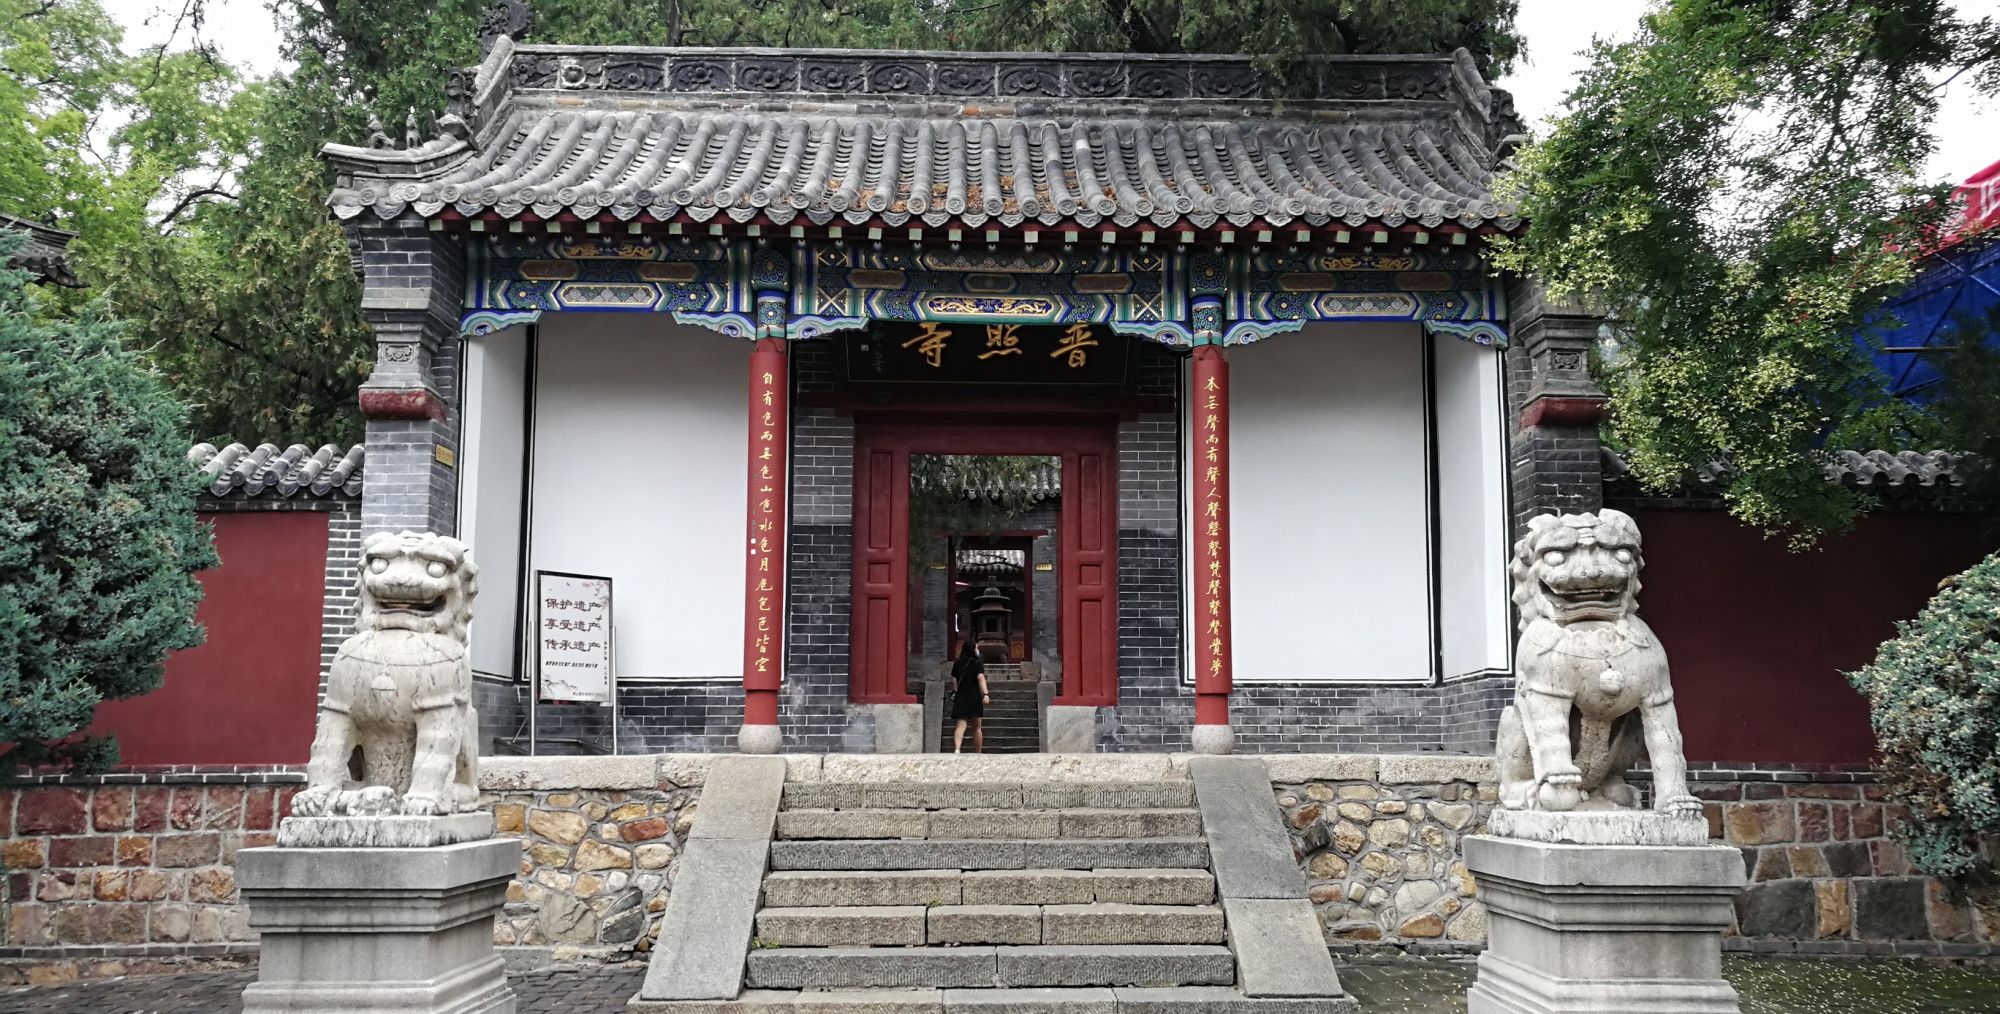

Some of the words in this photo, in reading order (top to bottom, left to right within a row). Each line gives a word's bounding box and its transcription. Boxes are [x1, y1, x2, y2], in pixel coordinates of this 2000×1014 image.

[901, 321, 1099, 368] 普照寺
[545, 598, 601, 611] 保护遗产
[544, 618, 601, 632] 享受遗产
[544, 638, 600, 652] 传承遗产
